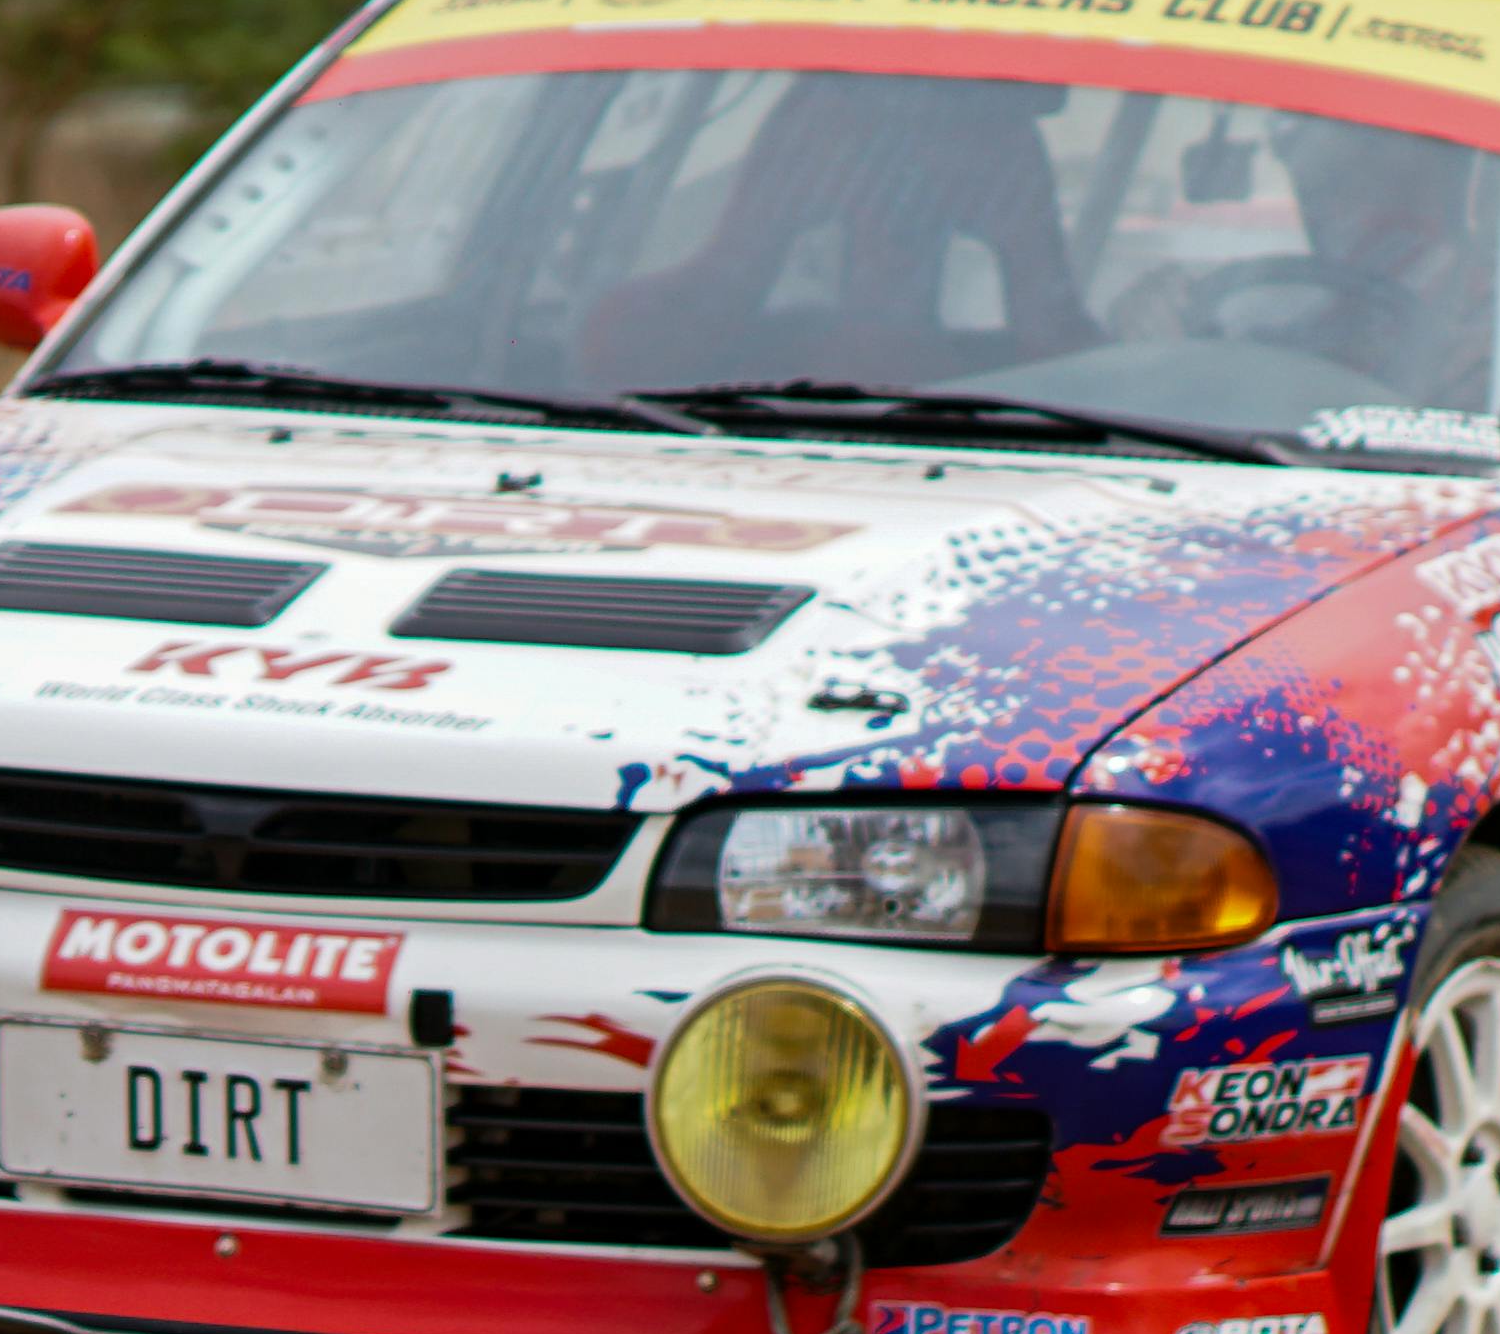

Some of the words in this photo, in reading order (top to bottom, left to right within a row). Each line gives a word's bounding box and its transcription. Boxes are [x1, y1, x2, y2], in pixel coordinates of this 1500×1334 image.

[124, 640, 457, 691] KYB
[34, 679, 132, 704] World
[137, 684, 222, 710] Class
[233, 692, 334, 717] Shock
[340, 700, 495, 733] Absorber
[57, 915, 387, 983] MOTOLITE
[1169, 1060, 1308, 1110] KEON
[127, 1065, 312, 1166] DIRT
[1160, 1096, 1356, 1145] SONDRA
